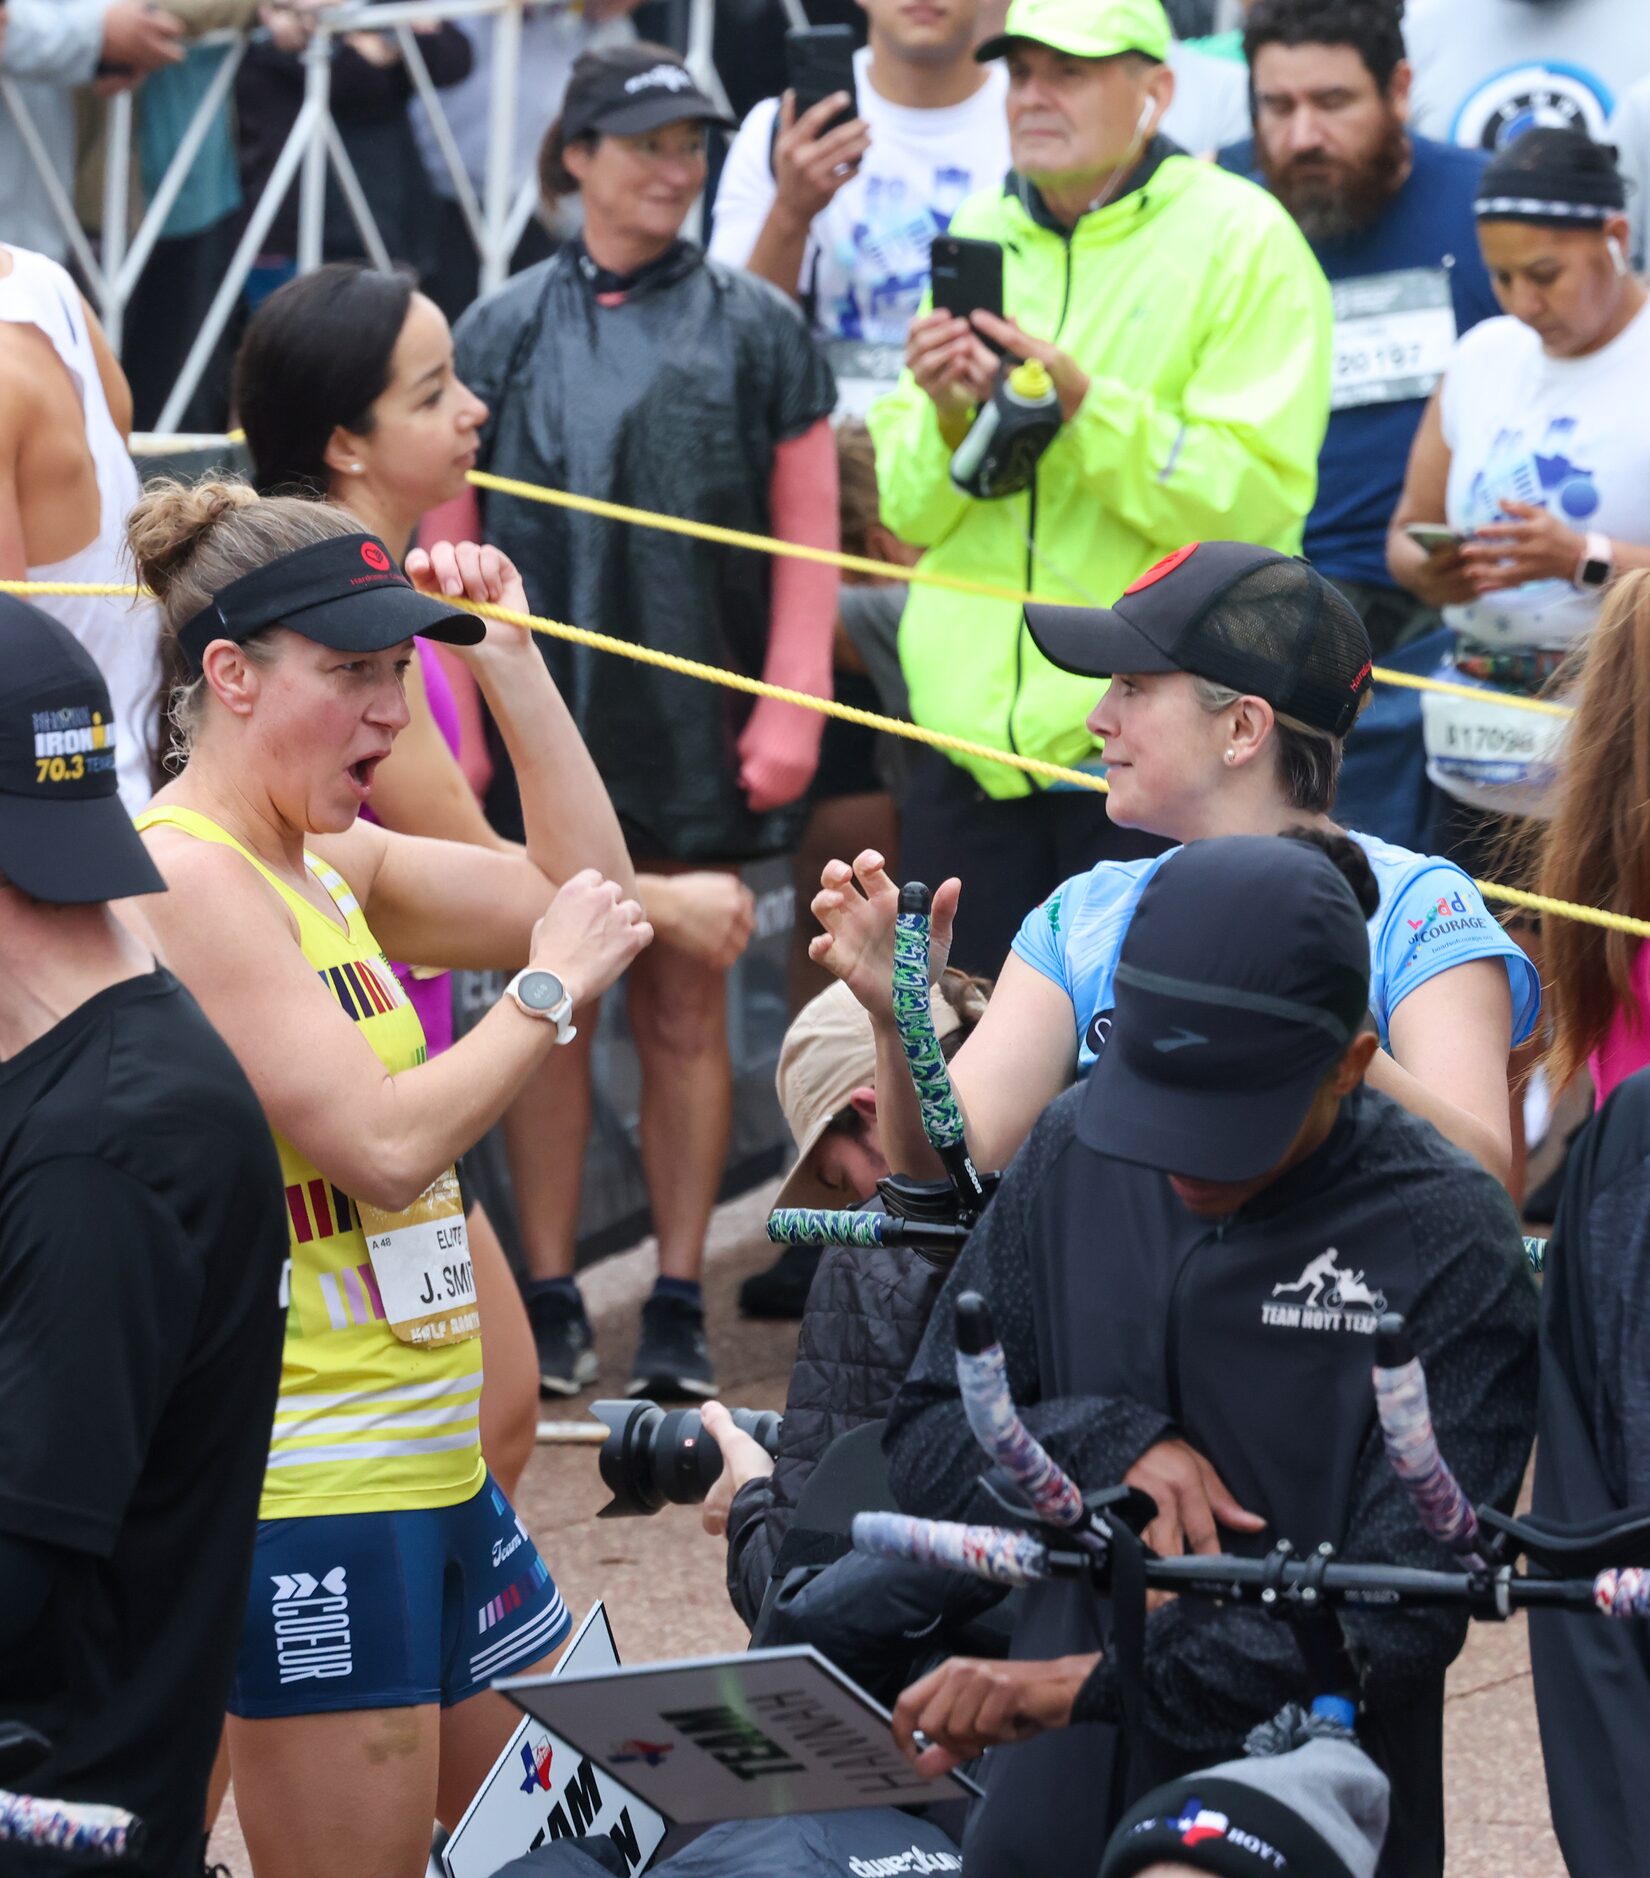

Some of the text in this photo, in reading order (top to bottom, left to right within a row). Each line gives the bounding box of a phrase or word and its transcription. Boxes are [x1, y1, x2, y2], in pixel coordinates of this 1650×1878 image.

[35, 754, 84, 783] 70.3
[1420, 917, 1487, 943] COURAGE
[372, 1237, 392, 1250] A 48
[420, 1272, 442, 1304] J.
[1261, 1303, 1300, 1328] TEAM
[1301, 1308, 1342, 1331] HOYT
[491, 1533, 521, 1568] Team
[271, 1595, 353, 1684] COEUR
[659, 1705, 808, 1782] TEAM
[743, 1690, 933, 1794] HANNAH
[529, 1757, 603, 1852] AM
[1226, 1826, 1287, 1870] HOYT
